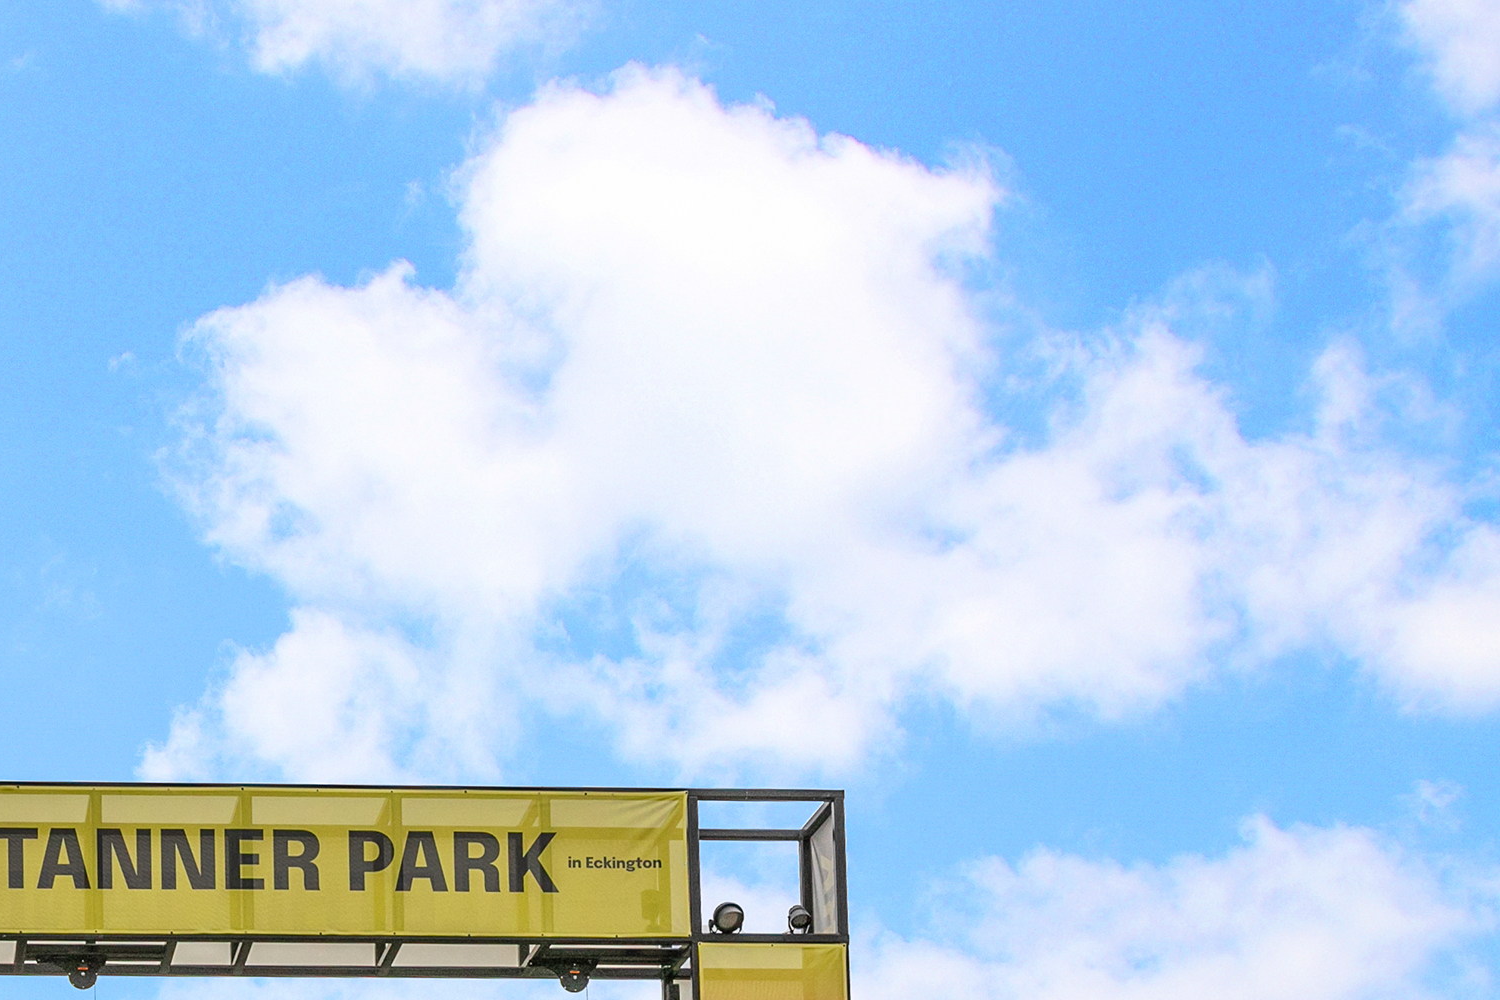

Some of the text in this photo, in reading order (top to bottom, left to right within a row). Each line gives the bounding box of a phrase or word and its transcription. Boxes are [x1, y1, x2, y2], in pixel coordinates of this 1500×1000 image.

[348, 830, 560, 893] PARK
[567, 855, 663, 873] in Eckington
